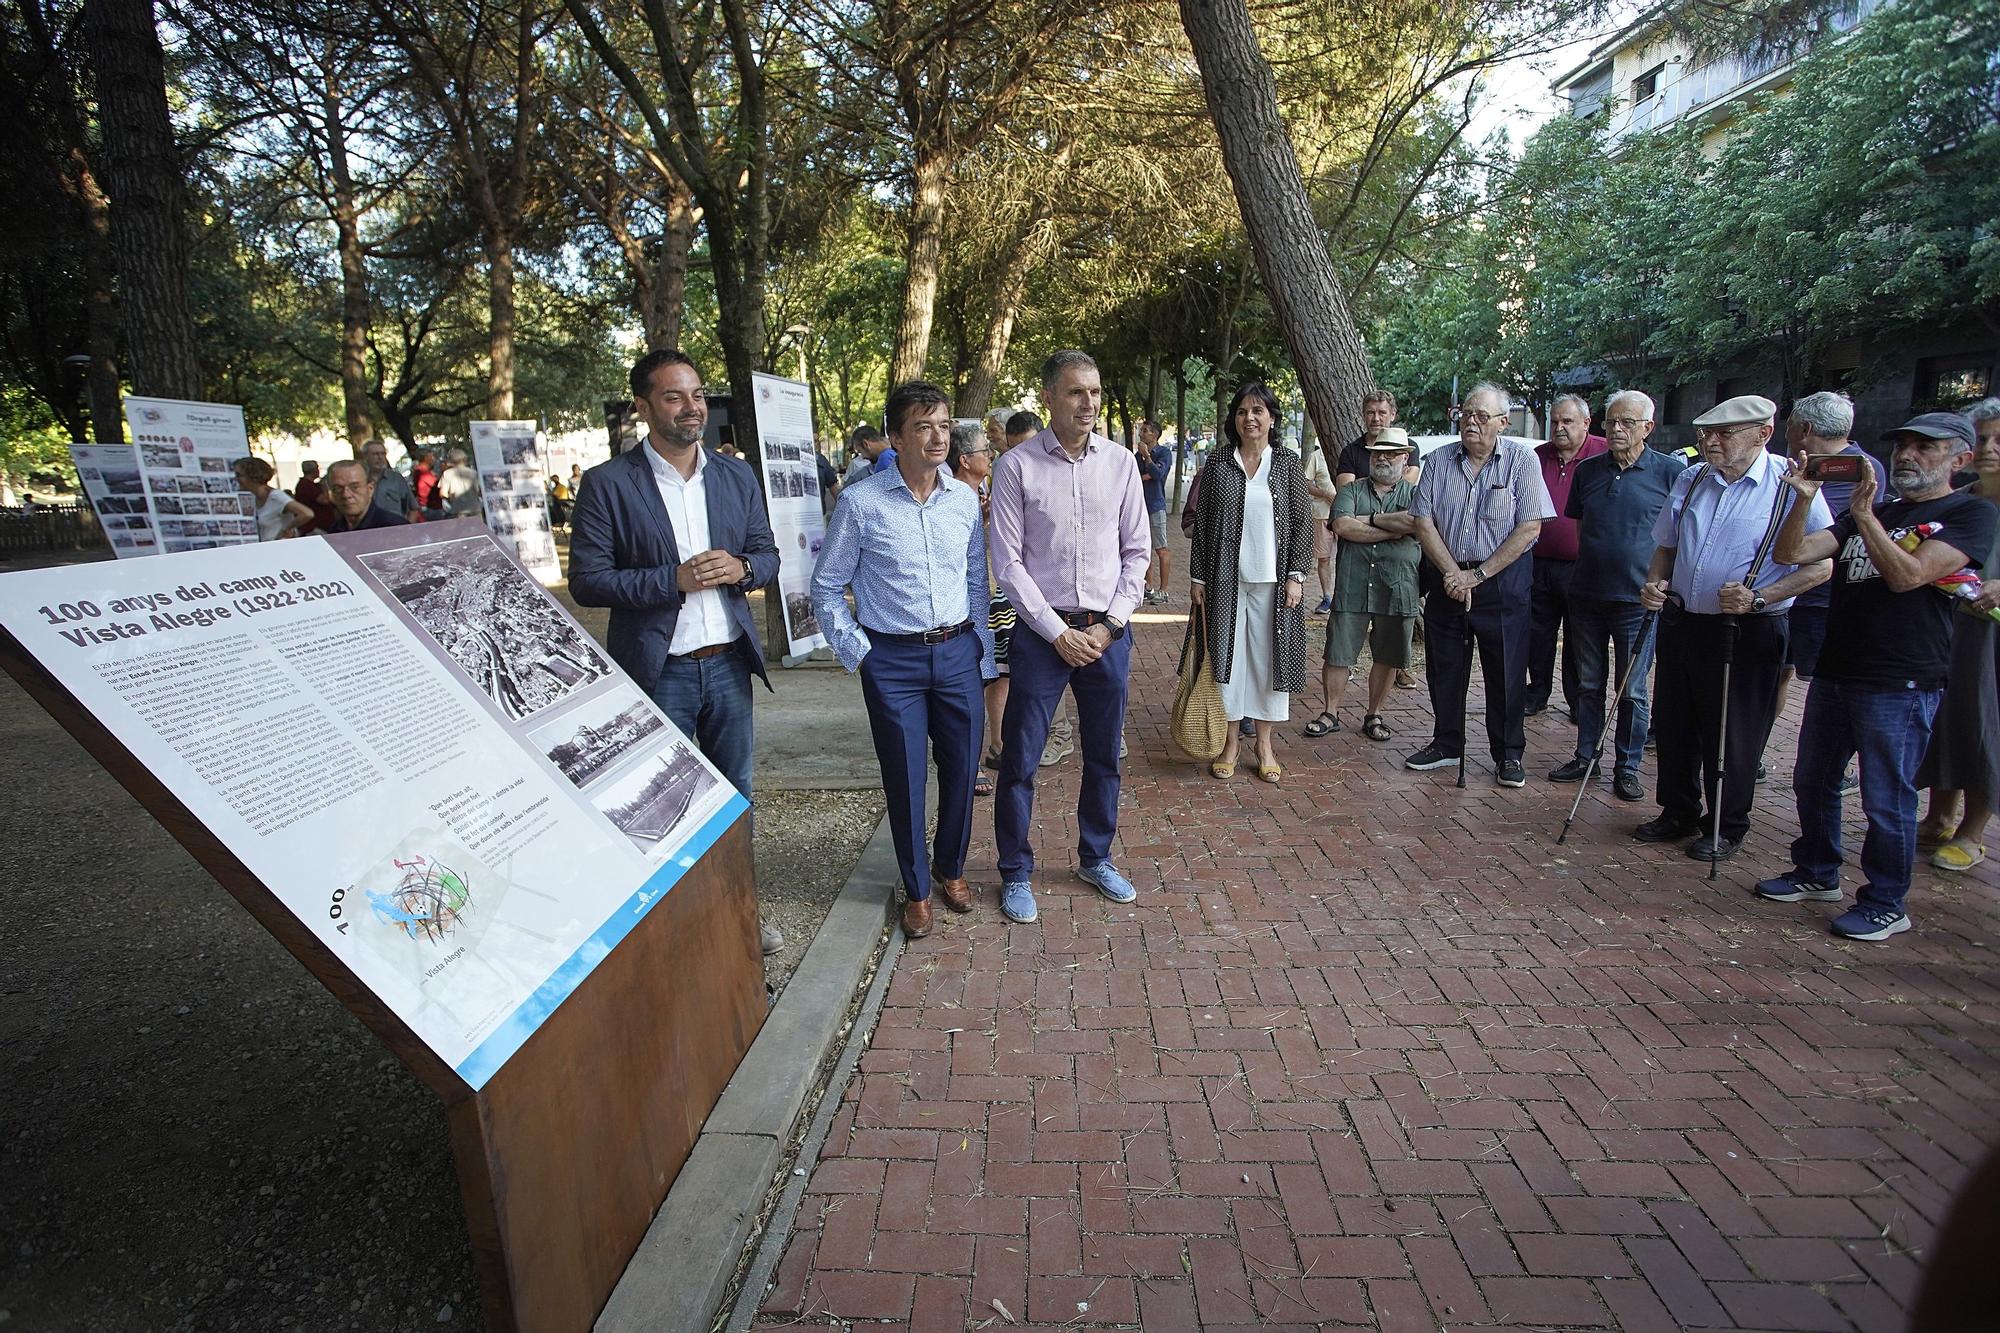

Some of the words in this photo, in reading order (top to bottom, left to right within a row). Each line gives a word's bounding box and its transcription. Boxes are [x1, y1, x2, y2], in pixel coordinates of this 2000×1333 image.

[38, 600, 103, 624] 100
[105, 592, 174, 613] anys
[174, 582, 217, 601] del
[216, 575, 278, 594] camp
[278, 569, 306, 584] de
[60, 623, 147, 646] Vista
[147, 606, 231, 632] Alegre
[229, 581, 355, 618] (1922-2022)
[438, 809, 451, 819] Que
[448, 802, 462, 813] boti
[458, 798, 472, 807] ben
[469, 792, 481, 801] fort
[440, 794, 455, 805] boti
[451, 790, 465, 799] ben
[451, 812, 468, 824] dintre
[466, 805, 477, 815] del
[475, 799, 490, 809] camp
[495, 787, 510, 798] dintre
[460, 832, 472, 842] Pel
[478, 822, 488, 832] del
[468, 840, 481, 850] Que
[479, 832, 494, 843] duen
[499, 820, 512, 830] salts
[424, 963, 445, 977] Vista
[443, 946, 465, 965] Alegre
